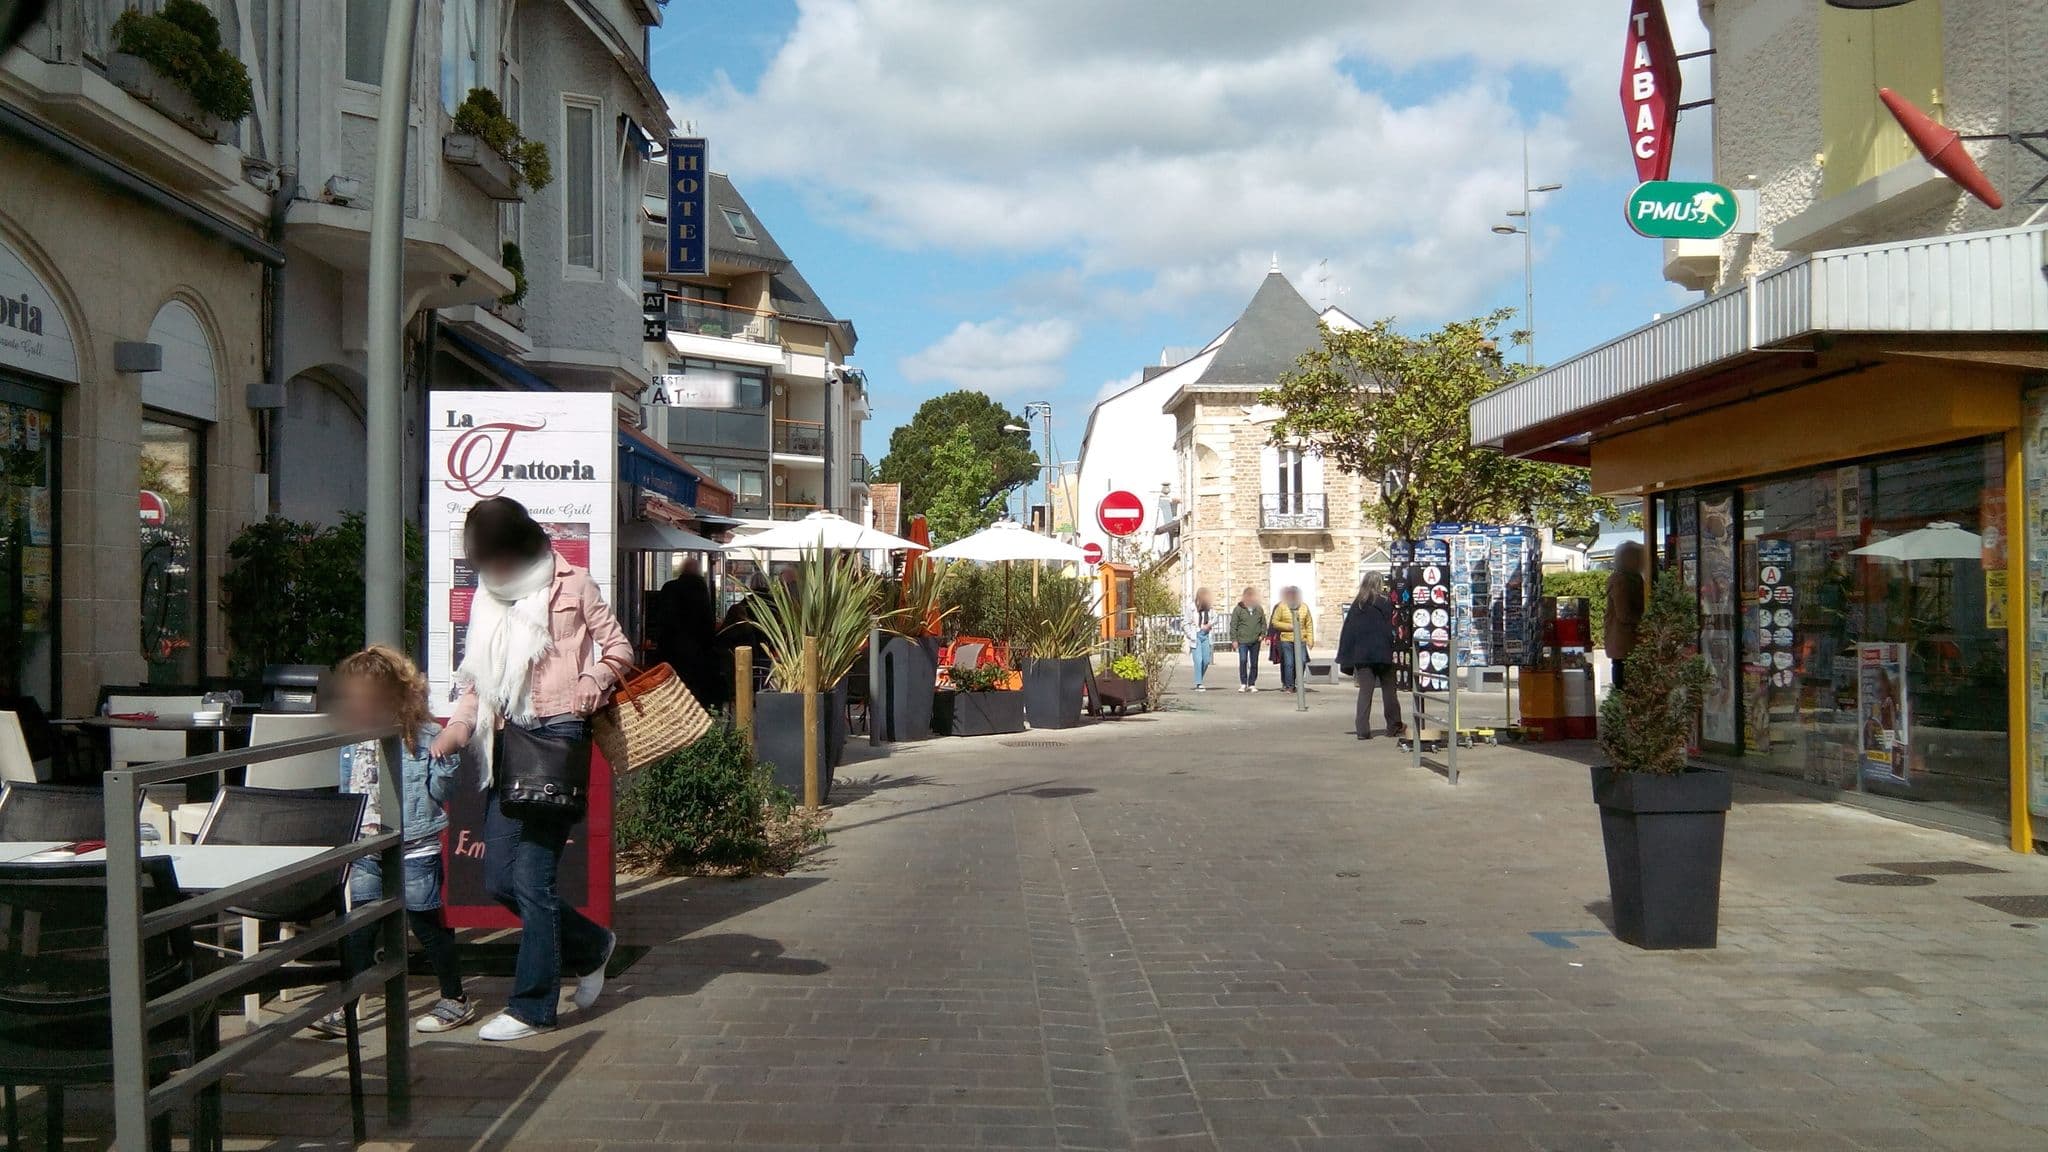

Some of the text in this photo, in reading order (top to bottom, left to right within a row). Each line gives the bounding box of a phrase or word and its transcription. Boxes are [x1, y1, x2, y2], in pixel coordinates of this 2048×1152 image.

[1633, 12, 1656, 160] TABAC
[677, 155, 698, 263] HOTEL
[1637, 200, 1691, 221] PMU
[445, 417, 596, 498] Trattoria
[446, 410, 474, 428] La
